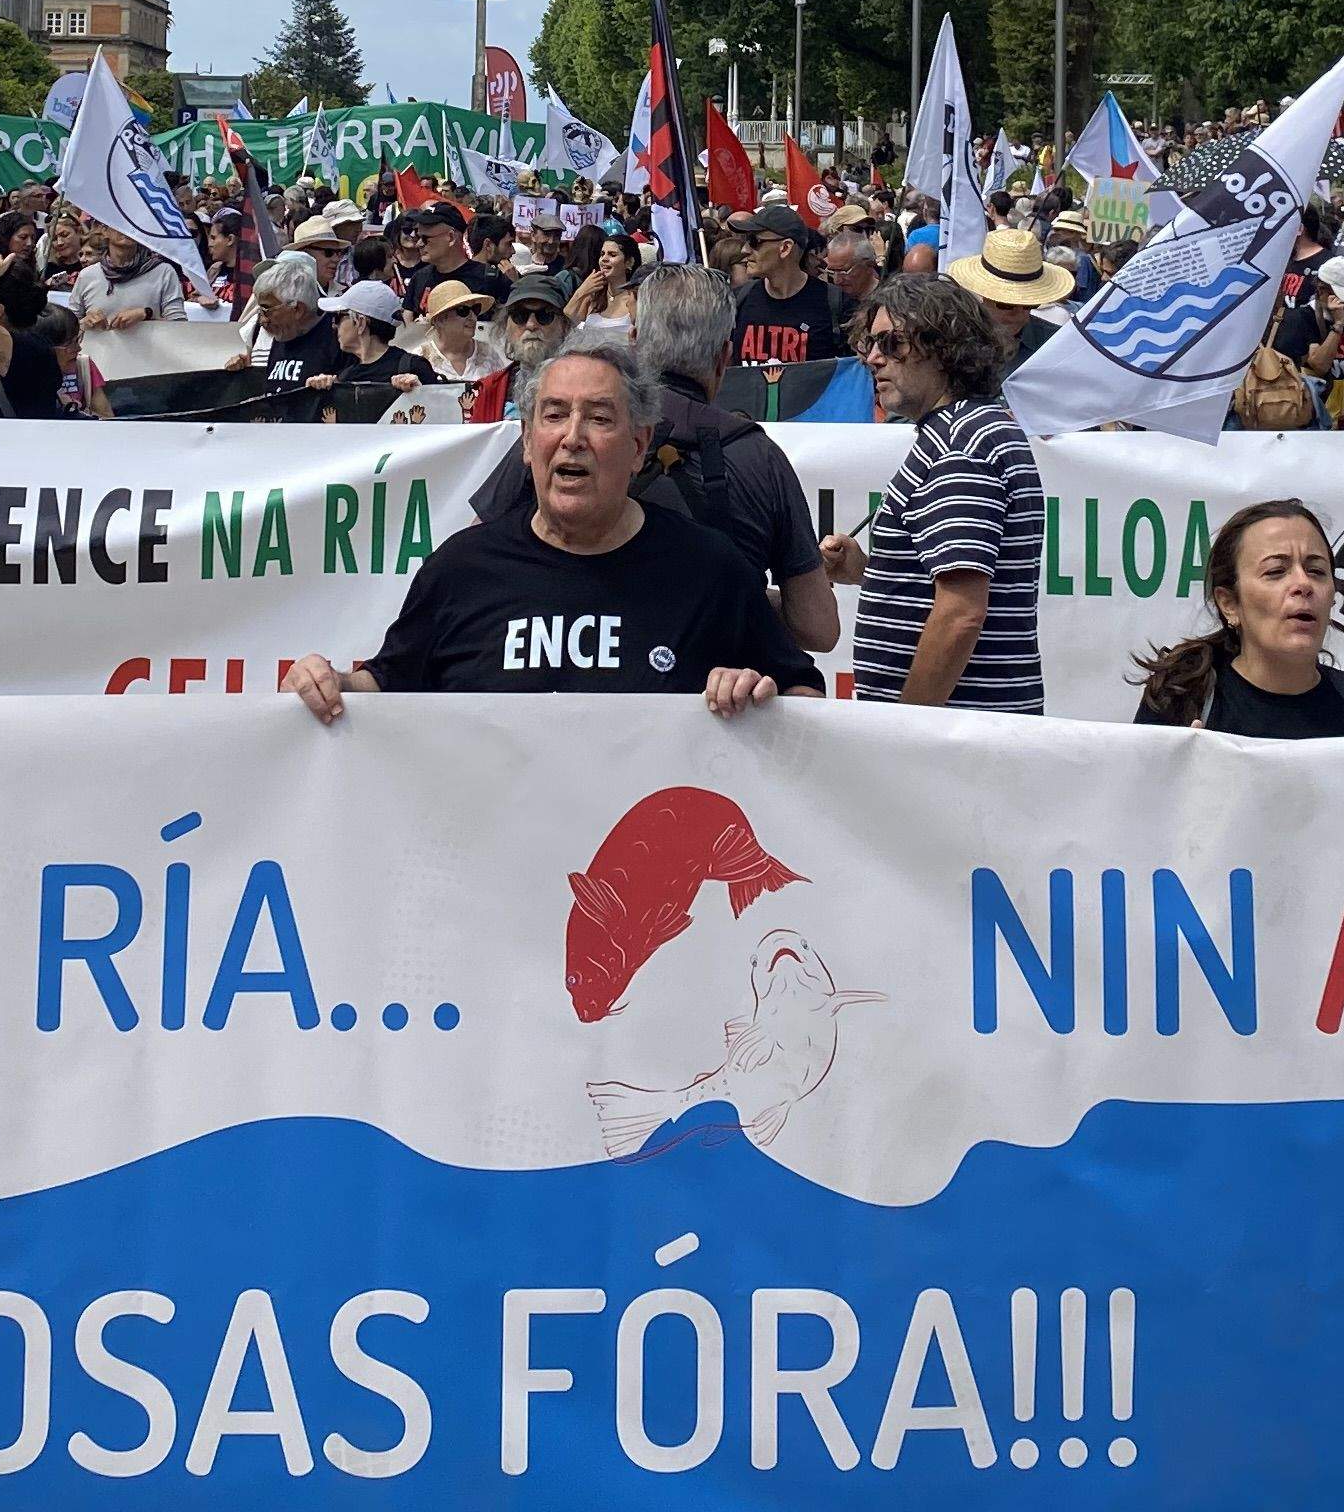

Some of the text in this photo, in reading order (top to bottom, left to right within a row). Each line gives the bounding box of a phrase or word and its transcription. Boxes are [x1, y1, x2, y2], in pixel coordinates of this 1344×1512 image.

[182, 112, 192, 123] P
[566, 212, 599, 226] ALTRI
[741, 324, 809, 363] ALTRI
[201, 488, 294, 580] NA
[323, 452, 436, 576] RÍA
[1046, 496, 1212, 598] LLOA
[504, 615, 622, 669] ENCE
[36, 811, 461, 1032] RÍA...
[971, 867, 1258, 1036] NIN
[500, 1232, 1138, 1475] FÓRA!!!
